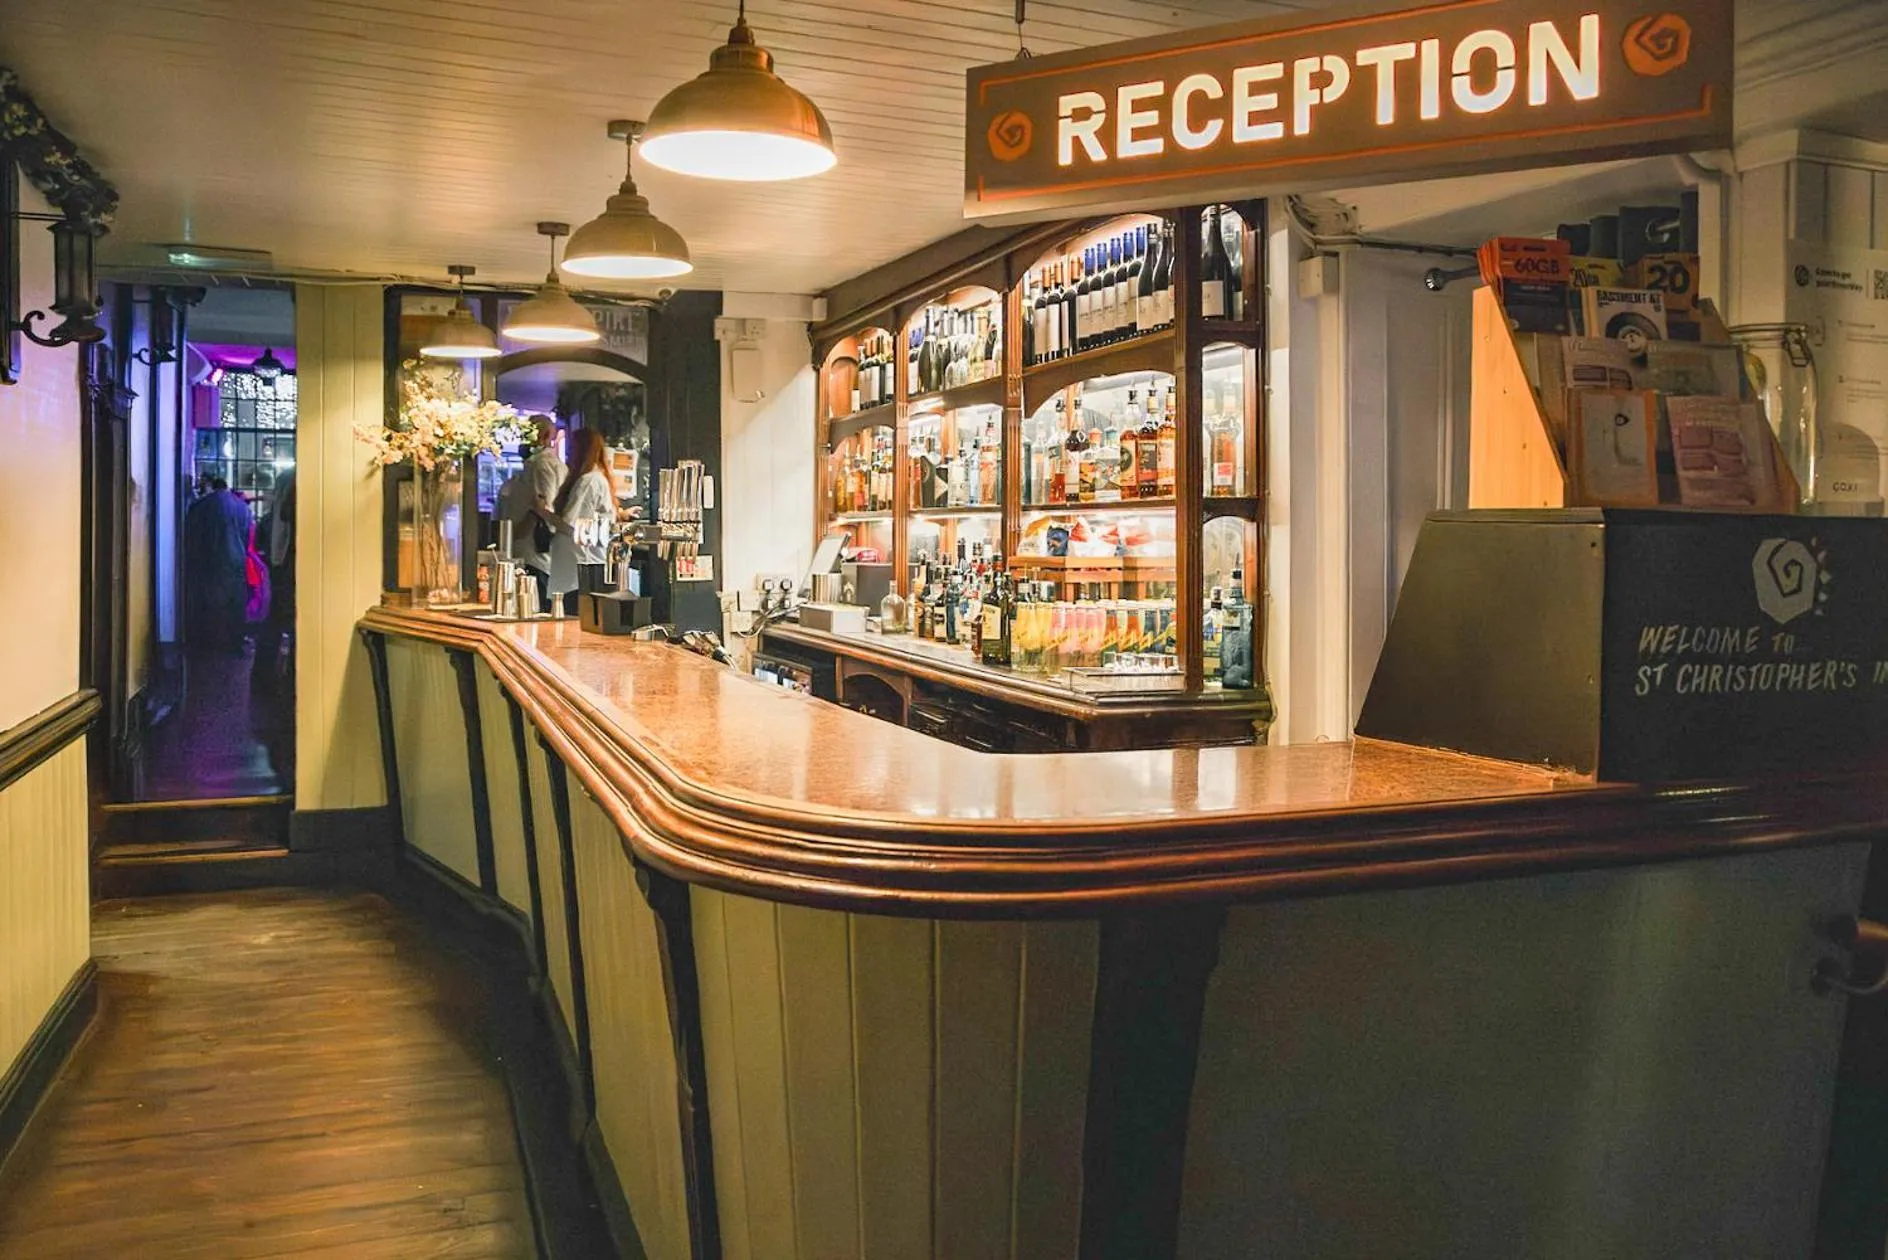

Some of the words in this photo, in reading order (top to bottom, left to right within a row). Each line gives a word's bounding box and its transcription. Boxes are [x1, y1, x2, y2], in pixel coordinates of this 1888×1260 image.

[1057, 12, 1601, 167] RECEPTION
[1638, 624, 1760, 655] WELCOME
[1635, 663, 1668, 697] ST
[1676, 660, 1858, 695] CHRISTOPHER'S
